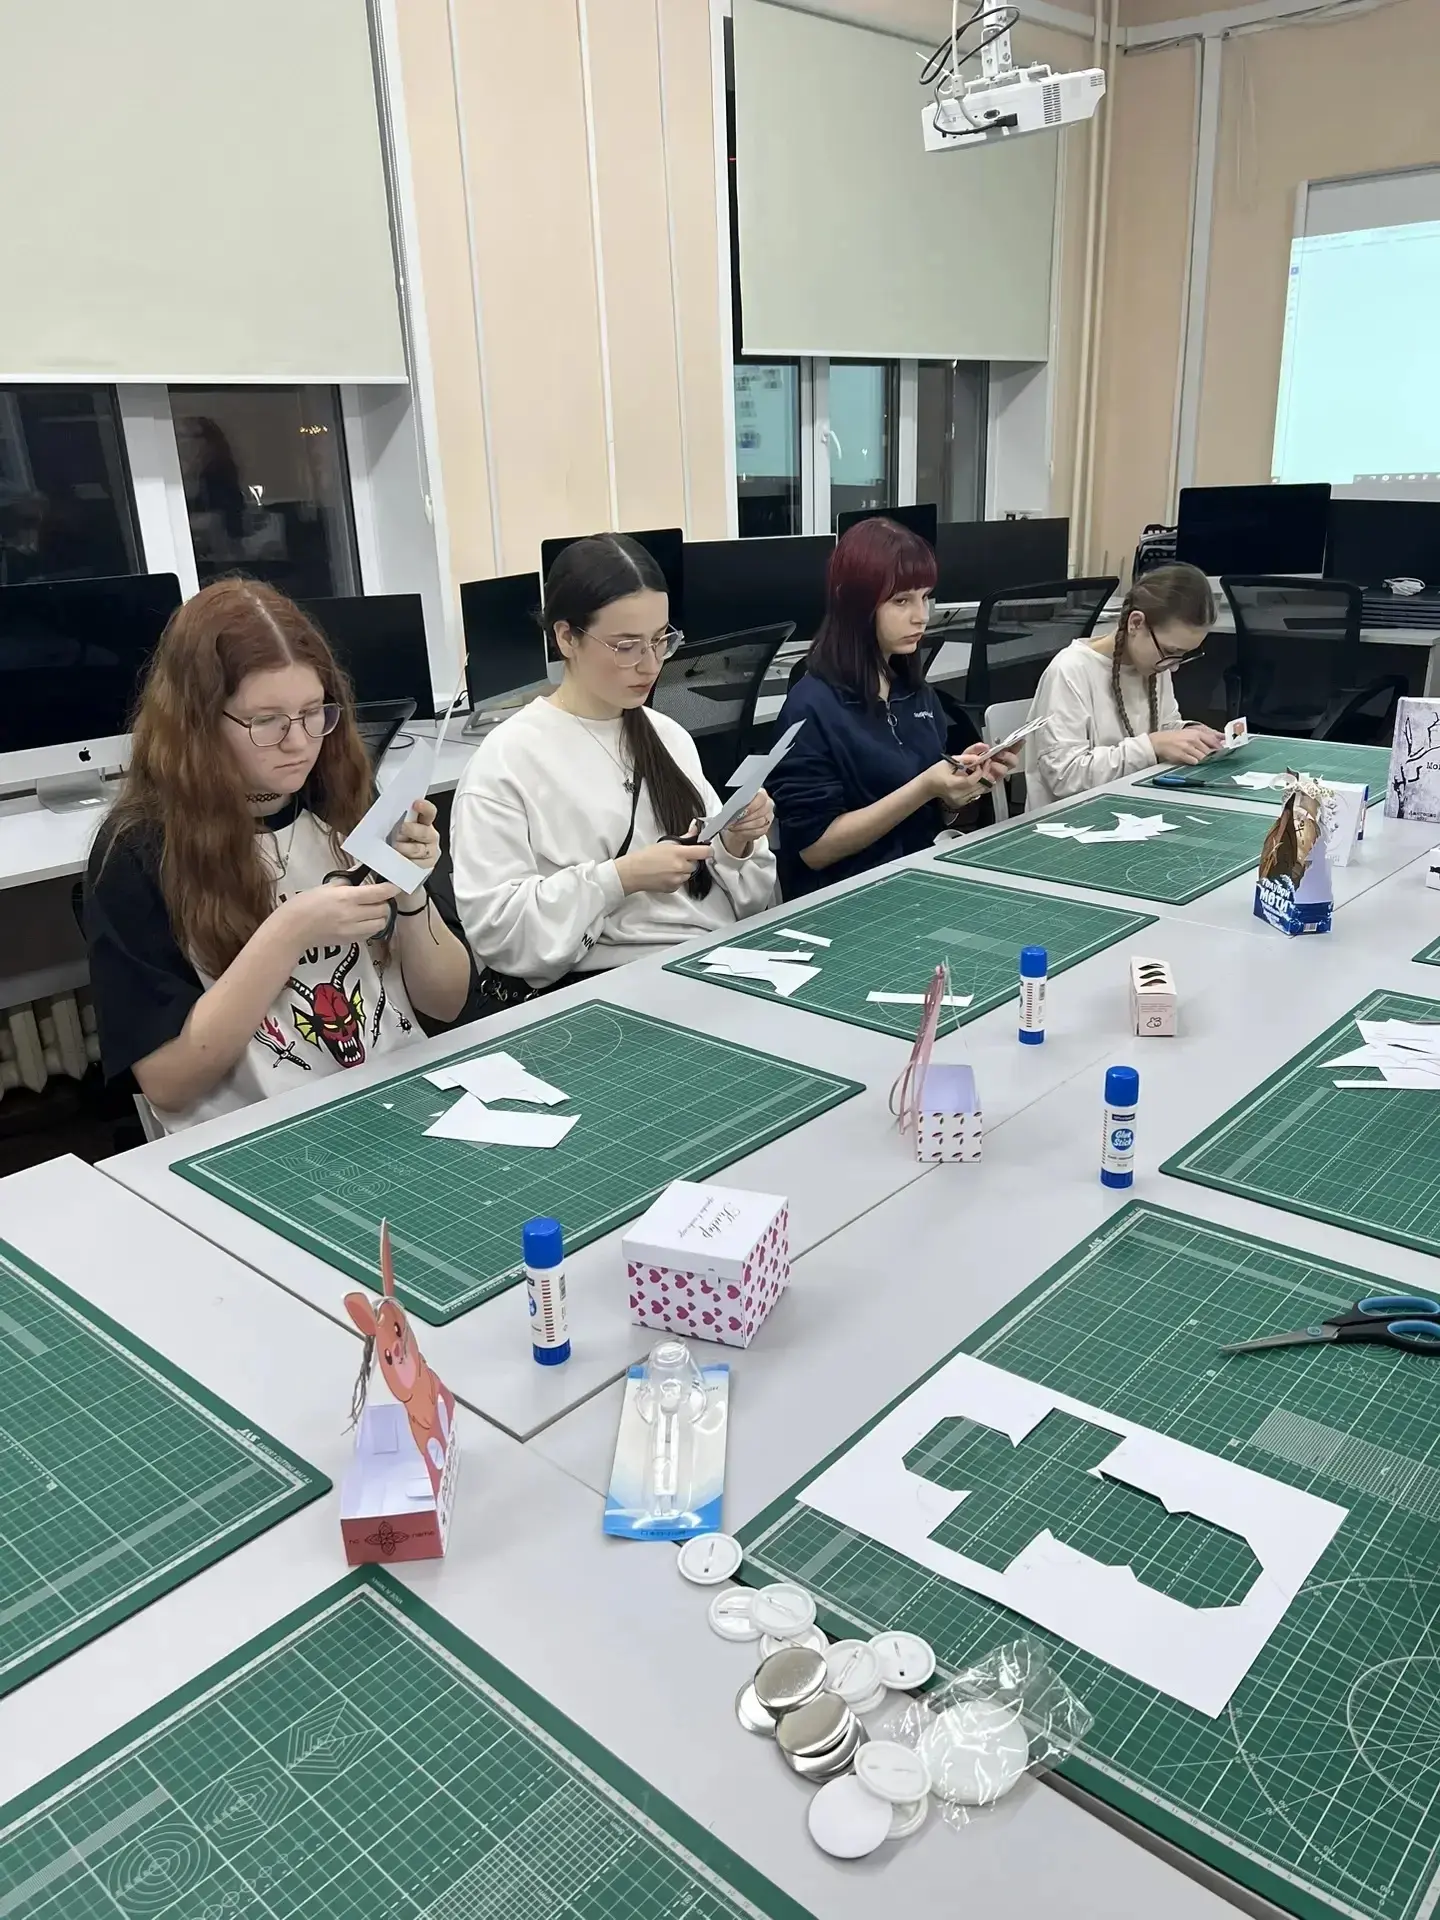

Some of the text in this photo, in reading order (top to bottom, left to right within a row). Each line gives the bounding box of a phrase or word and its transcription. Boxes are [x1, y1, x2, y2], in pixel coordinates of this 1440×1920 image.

[299, 944, 342, 966] UB
[1114, 1138, 1132, 1147] Stick
[259, 1442, 277, 1457] EXPERT
[275, 1455, 296, 1472] CUTTING
